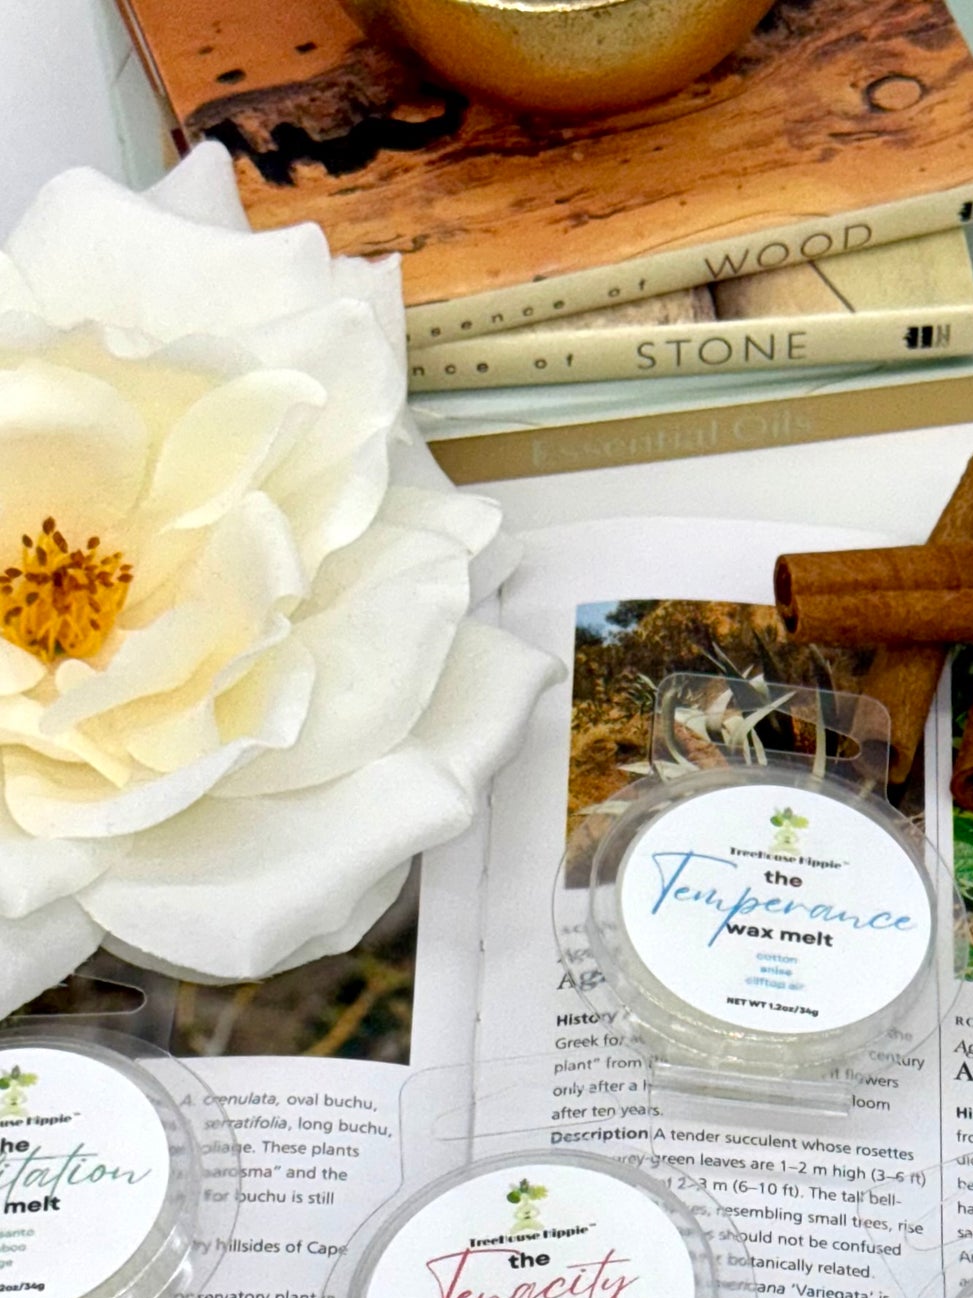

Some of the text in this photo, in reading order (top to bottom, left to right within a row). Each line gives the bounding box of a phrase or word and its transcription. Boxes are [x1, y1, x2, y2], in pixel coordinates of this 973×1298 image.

[608, 224, 872, 298] of WOOD
[534, 330, 808, 370] of STONE
[531, 420, 718, 469] Essential
[764, 870, 802, 888] the
[652, 850, 916, 947] Temperance
[727, 923, 833, 947] wax melt
[756, 952, 798, 964] cotton
[726, 997, 819, 1017] NET WT 1.2oz/34g
[287, 1094, 378, 1112] oval buchu,
[0, 1138, 30, 1153] he
[550, 1126, 915, 1162] Description A tender succulent whose rosettes
[4, 1195, 61, 1214] melt
[508, 1252, 550, 1269] the
